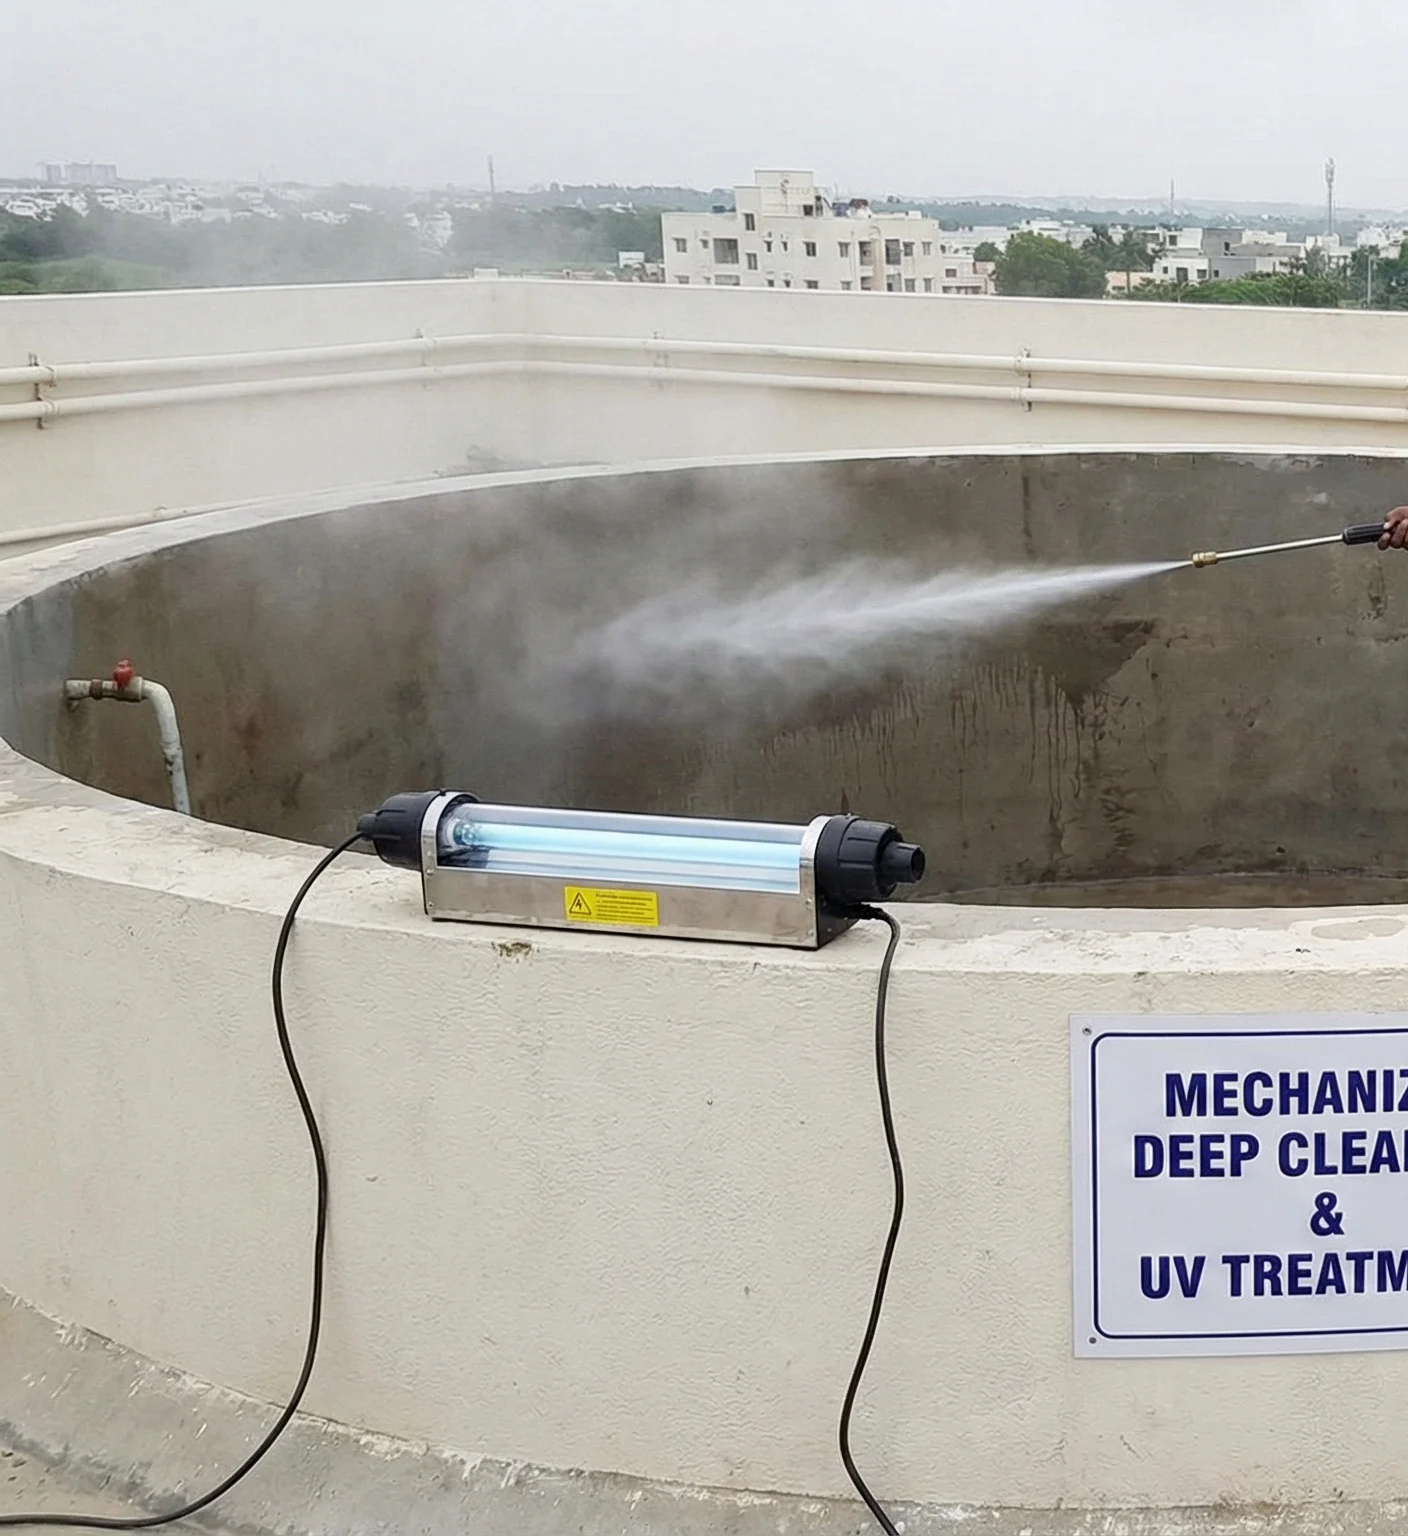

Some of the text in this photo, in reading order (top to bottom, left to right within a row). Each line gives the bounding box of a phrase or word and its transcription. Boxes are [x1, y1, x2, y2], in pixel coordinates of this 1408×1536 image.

[1134, 1133, 1260, 1178] DEEP
[1309, 1191, 1345, 1237] &
[1140, 1255, 1206, 1300] UV
